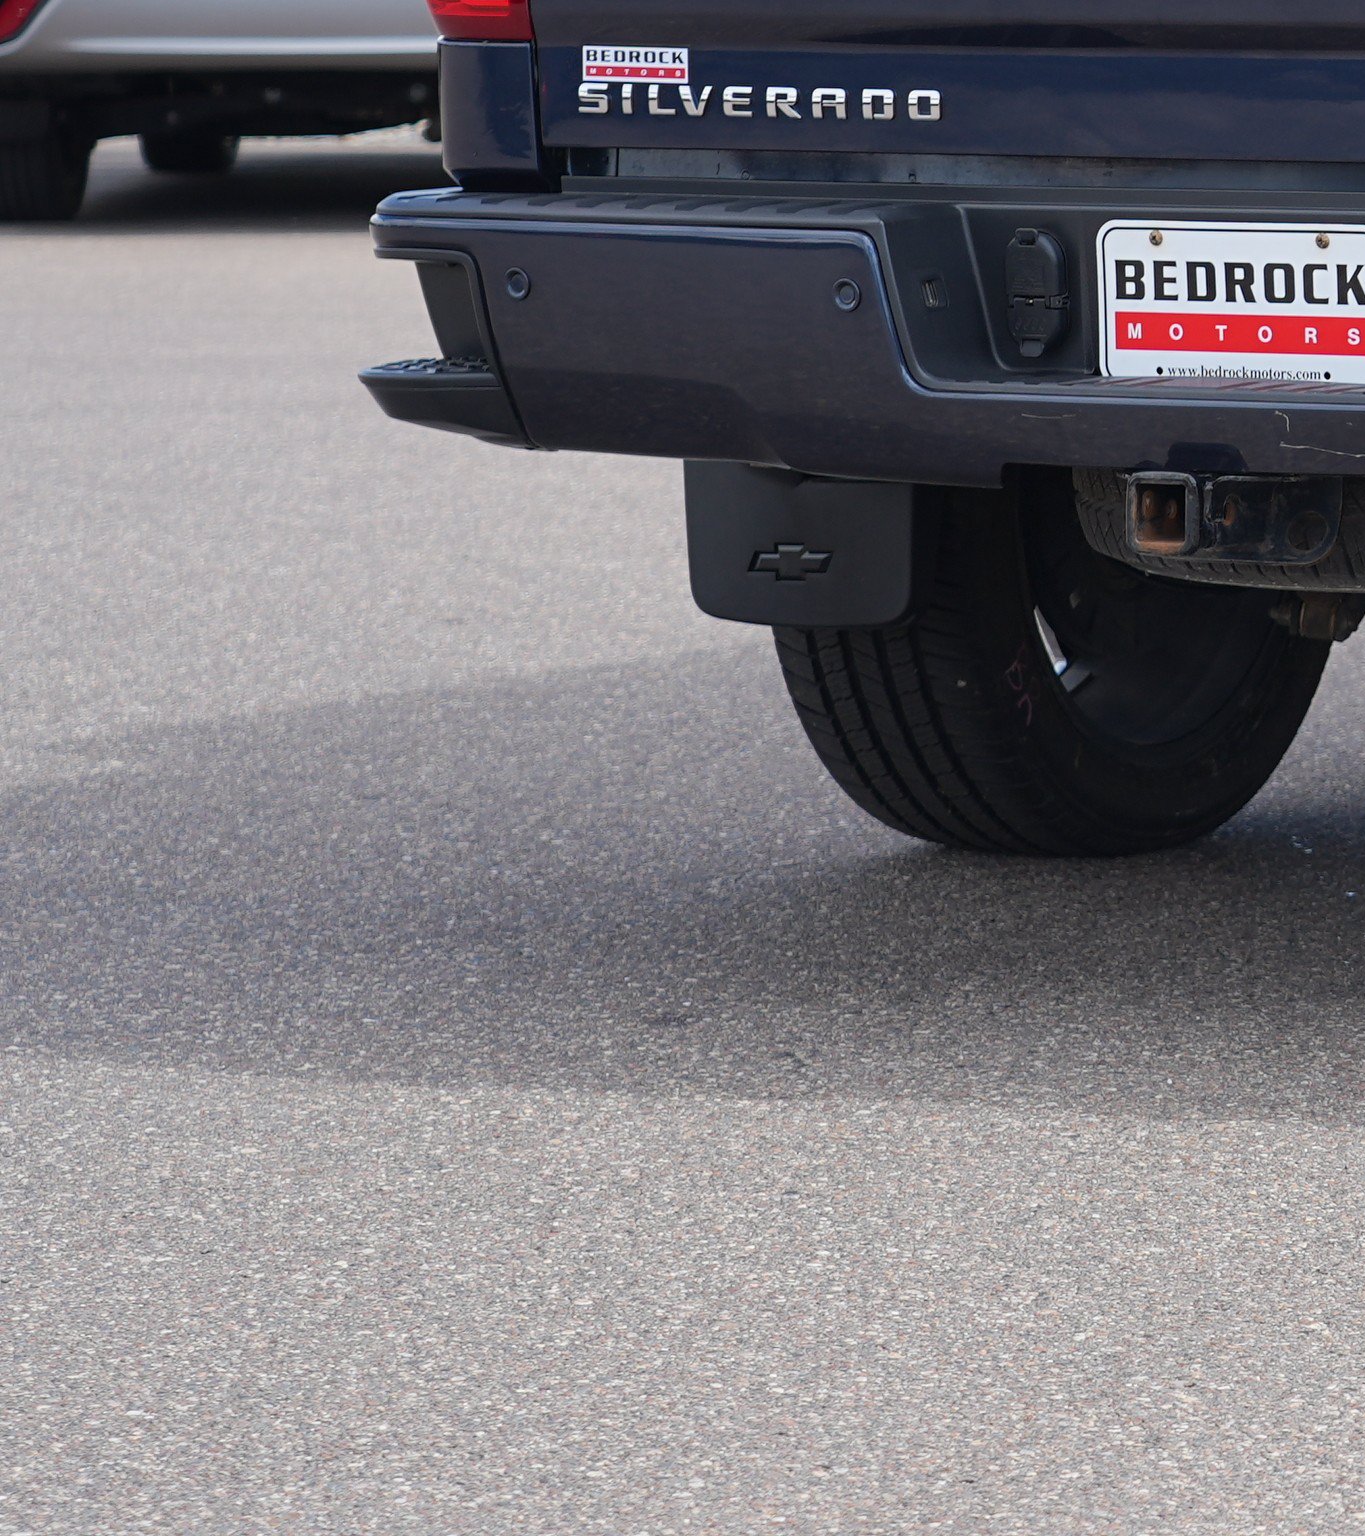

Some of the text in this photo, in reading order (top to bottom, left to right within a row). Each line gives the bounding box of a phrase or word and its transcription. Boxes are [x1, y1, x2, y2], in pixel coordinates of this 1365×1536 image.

[586, 48, 685, 65] BEDROCK
[589, 66, 683, 78] MOTORS
[578, 82, 942, 121] SILVERADO
[1127, 322, 1361, 346] MOTORS
[1167, 365, 1322, 381] www.bedrockmotors.com
